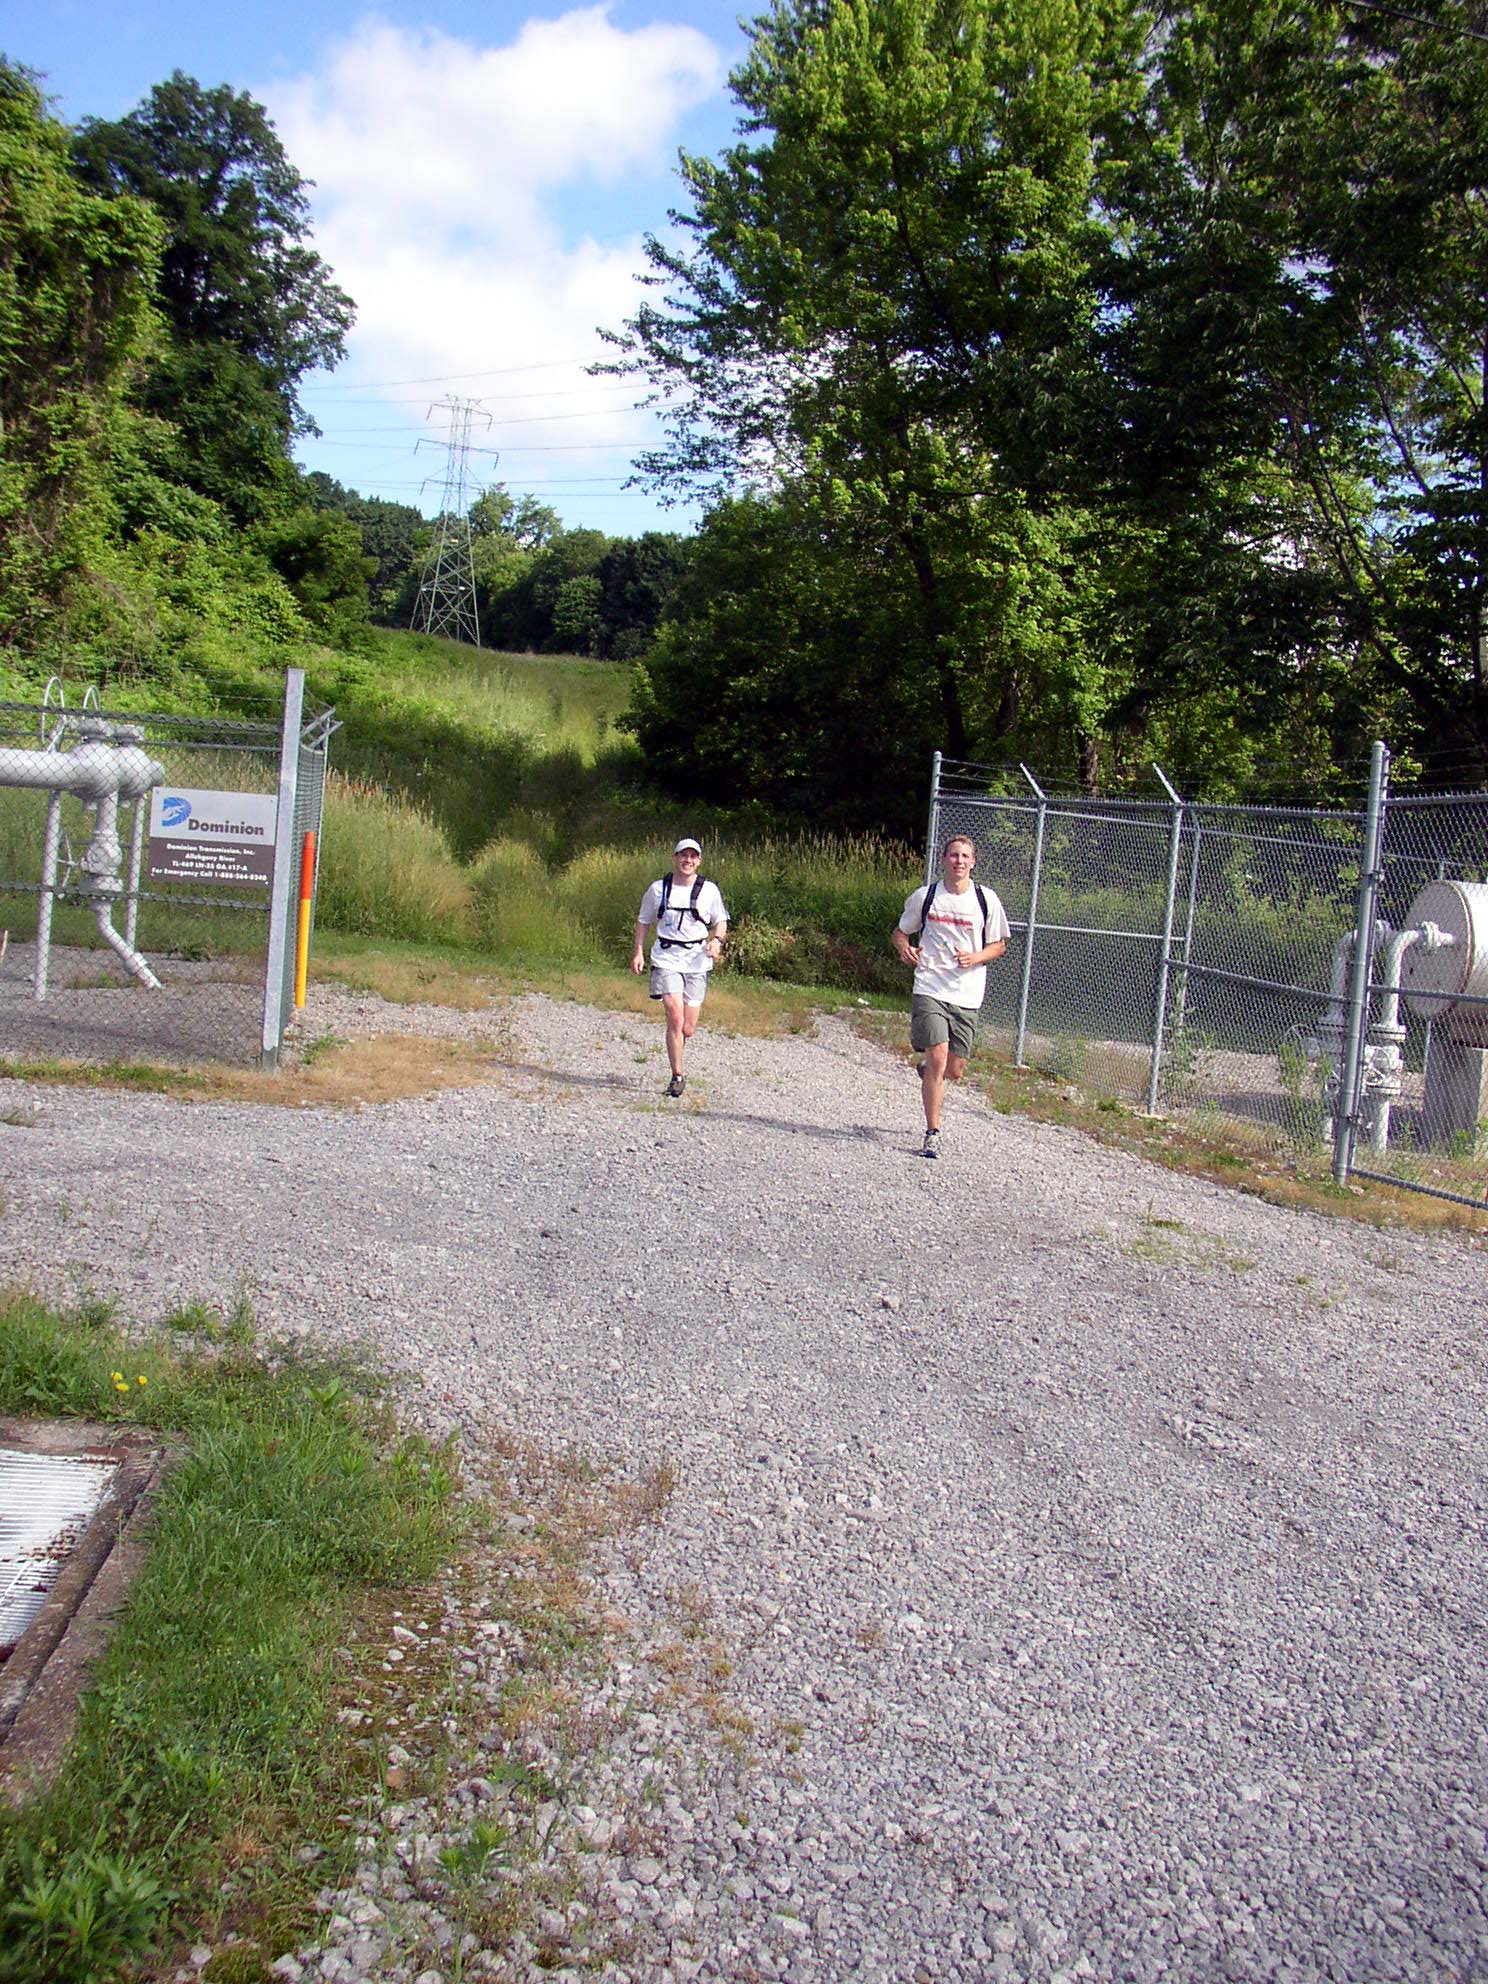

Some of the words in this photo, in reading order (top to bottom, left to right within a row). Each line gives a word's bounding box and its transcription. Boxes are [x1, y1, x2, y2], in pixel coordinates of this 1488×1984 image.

[188, 818, 265, 836] Dominion
[163, 868, 199, 877] Emergency
[200, 870, 213, 878] Call
